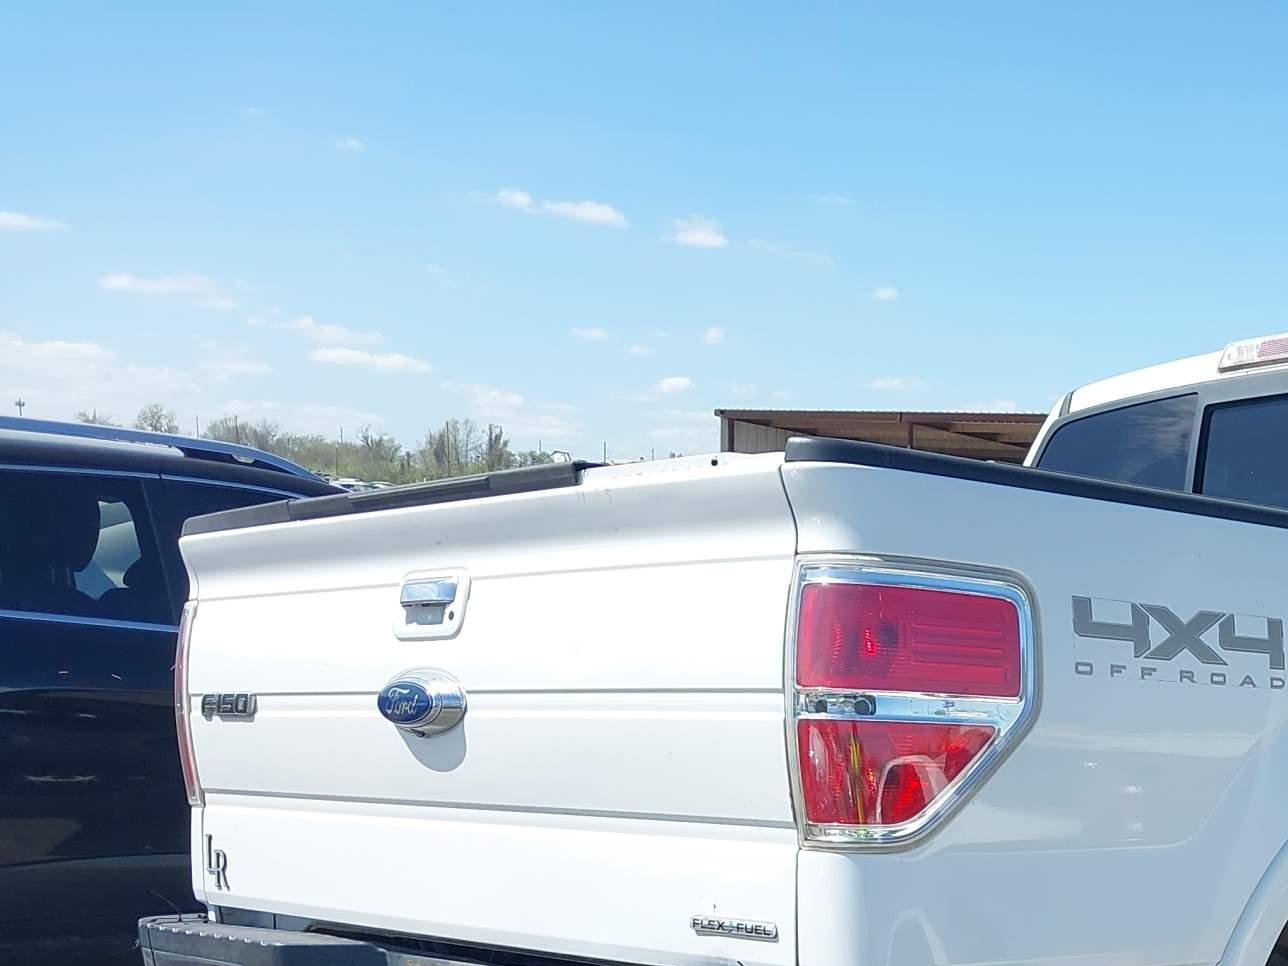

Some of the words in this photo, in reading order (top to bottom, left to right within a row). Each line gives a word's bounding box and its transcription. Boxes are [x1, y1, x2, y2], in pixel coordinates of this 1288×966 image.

[1071, 595, 1286, 670] 4X4
[386, 687, 419, 715] Ford
[692, 918, 726, 932] FLEX
[736, 922, 773, 937] FUEL
